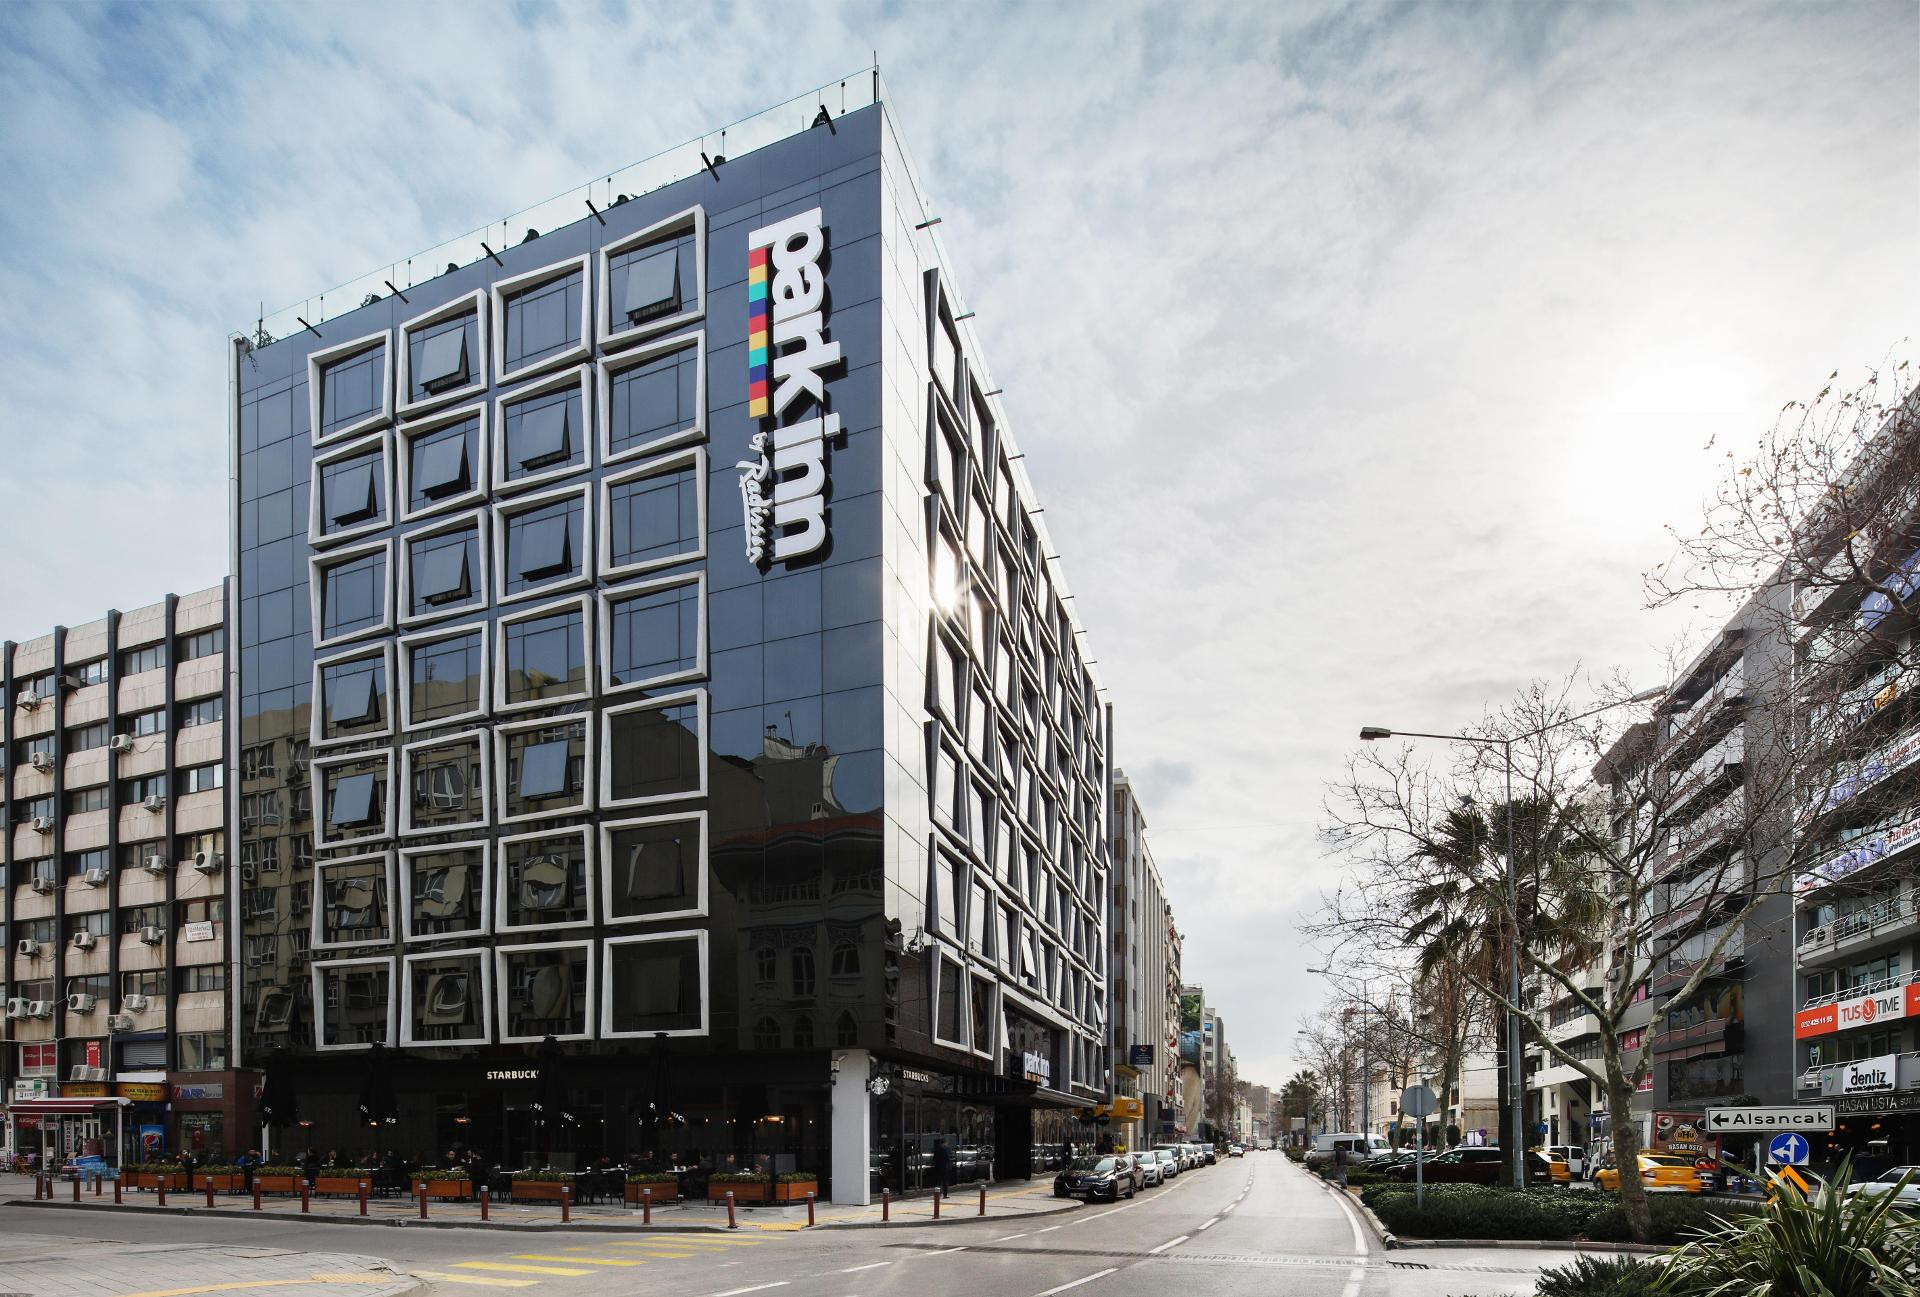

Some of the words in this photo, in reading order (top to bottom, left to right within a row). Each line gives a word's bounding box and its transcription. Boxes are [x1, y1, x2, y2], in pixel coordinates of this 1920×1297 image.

[749, 207, 841, 417] park
[748, 431, 768, 450] by
[774, 412, 841, 560] inn
[1841, 1005, 1861, 1022] TUS
[1876, 996, 1900, 1014] TIME
[903, 1069, 929, 1083] STARBUCKS
[1850, 1066, 1886, 1086] dentiz
[1839, 1098, 1868, 1113] HASAN
[1871, 1096, 1898, 1110] USTA
[1733, 1112, 1828, 1125] Alsancak
